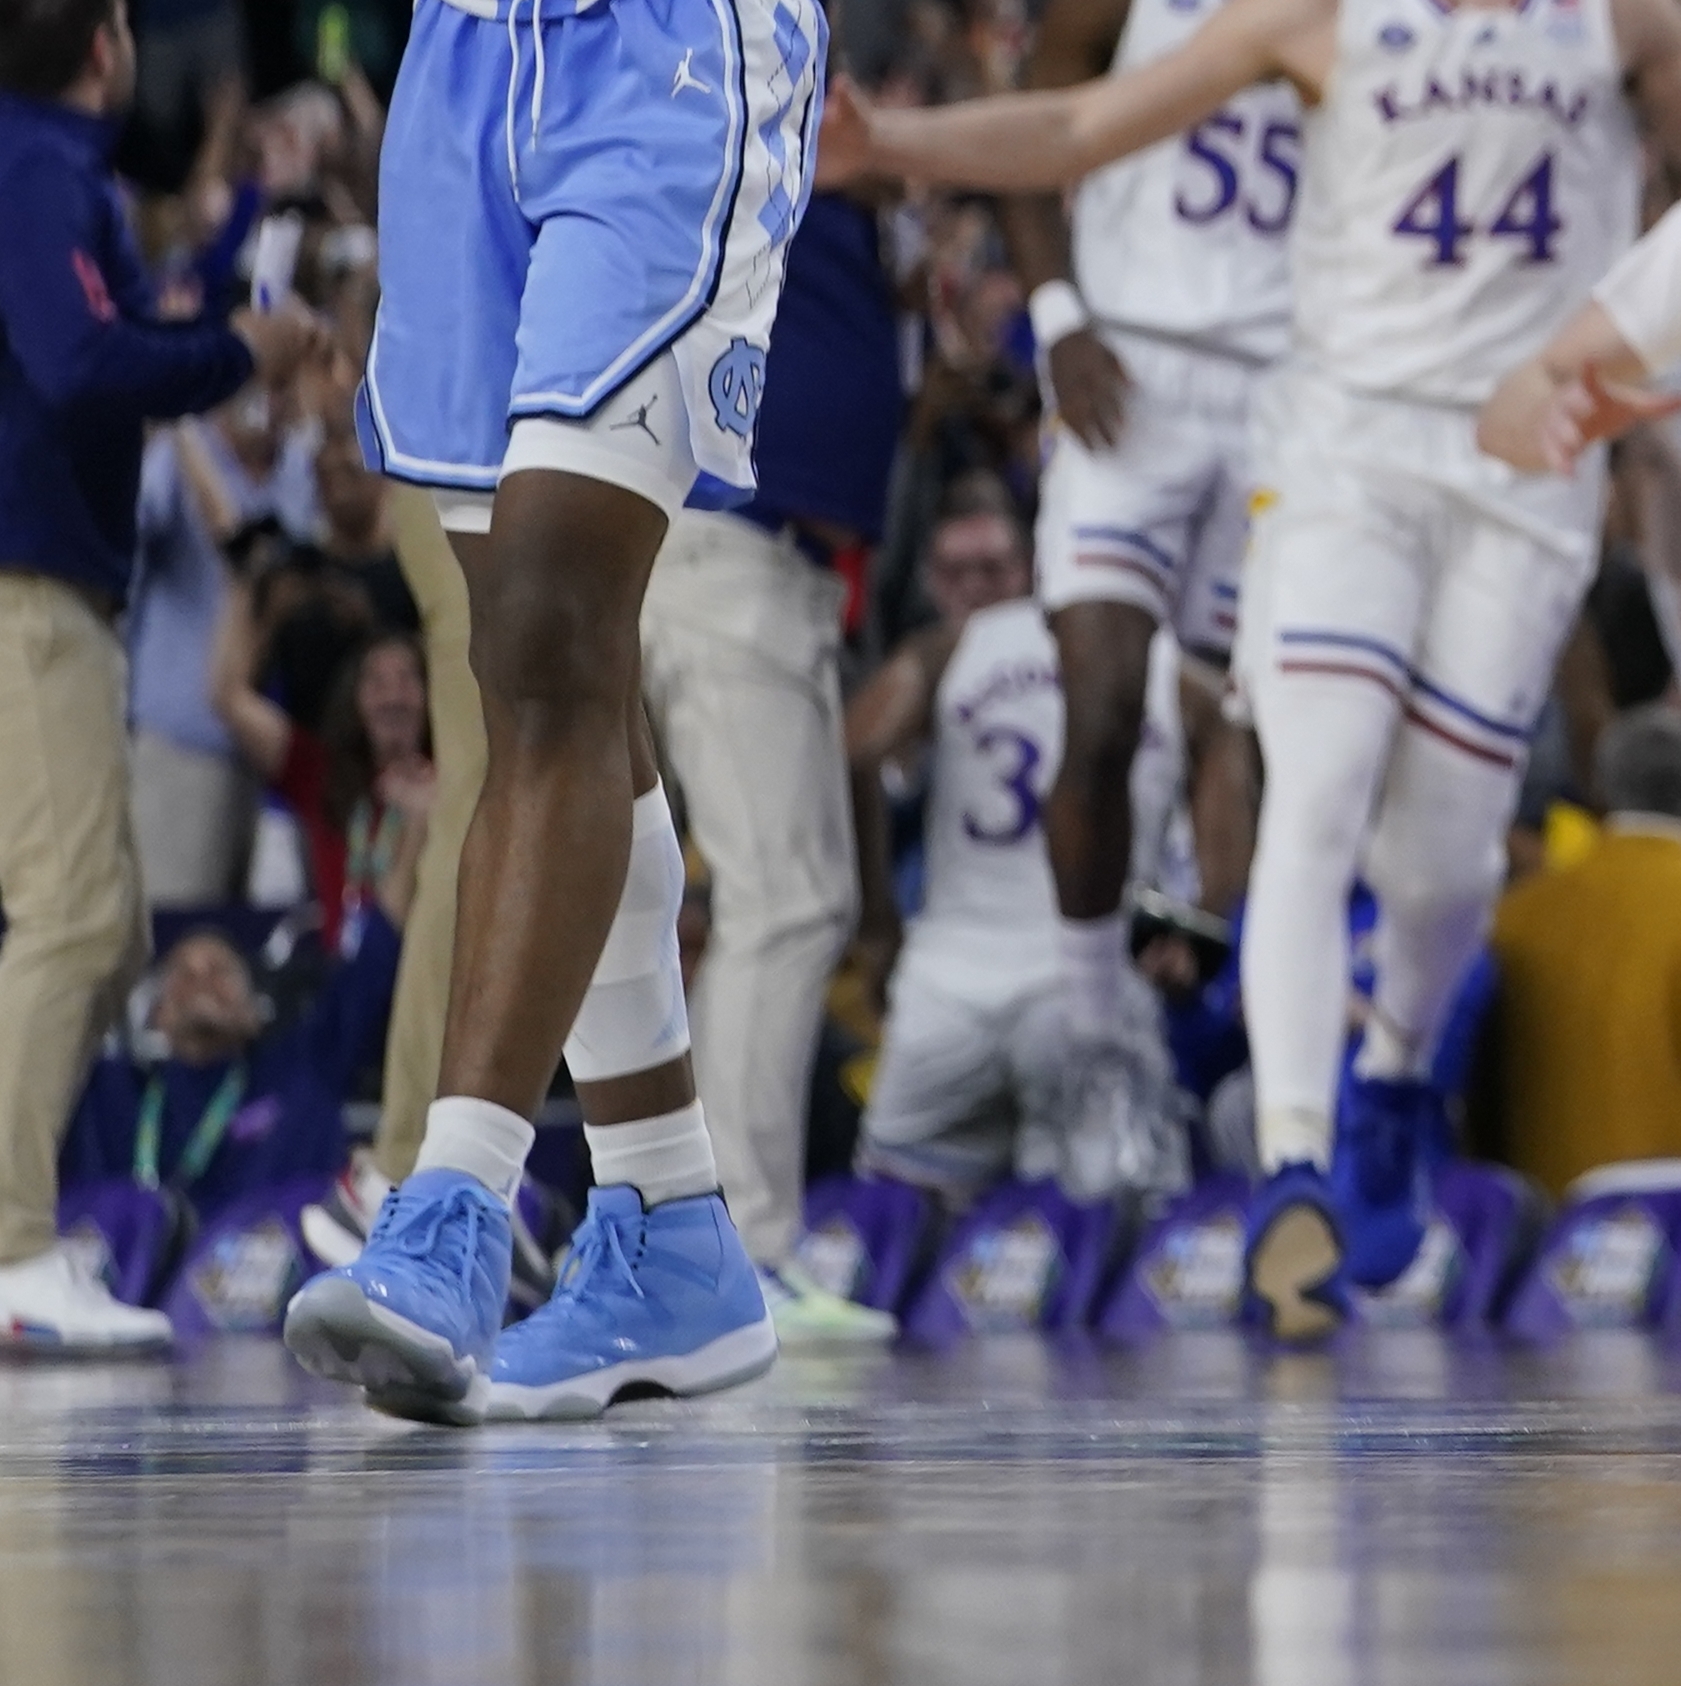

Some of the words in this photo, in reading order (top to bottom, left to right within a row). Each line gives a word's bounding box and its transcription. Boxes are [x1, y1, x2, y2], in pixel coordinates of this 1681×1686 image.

[1373, 66, 1588, 125] KANSAS
[1174, 113, 1300, 237] 55
[1391, 152, 1564, 267] 44
[961, 724, 1042, 849] 3
